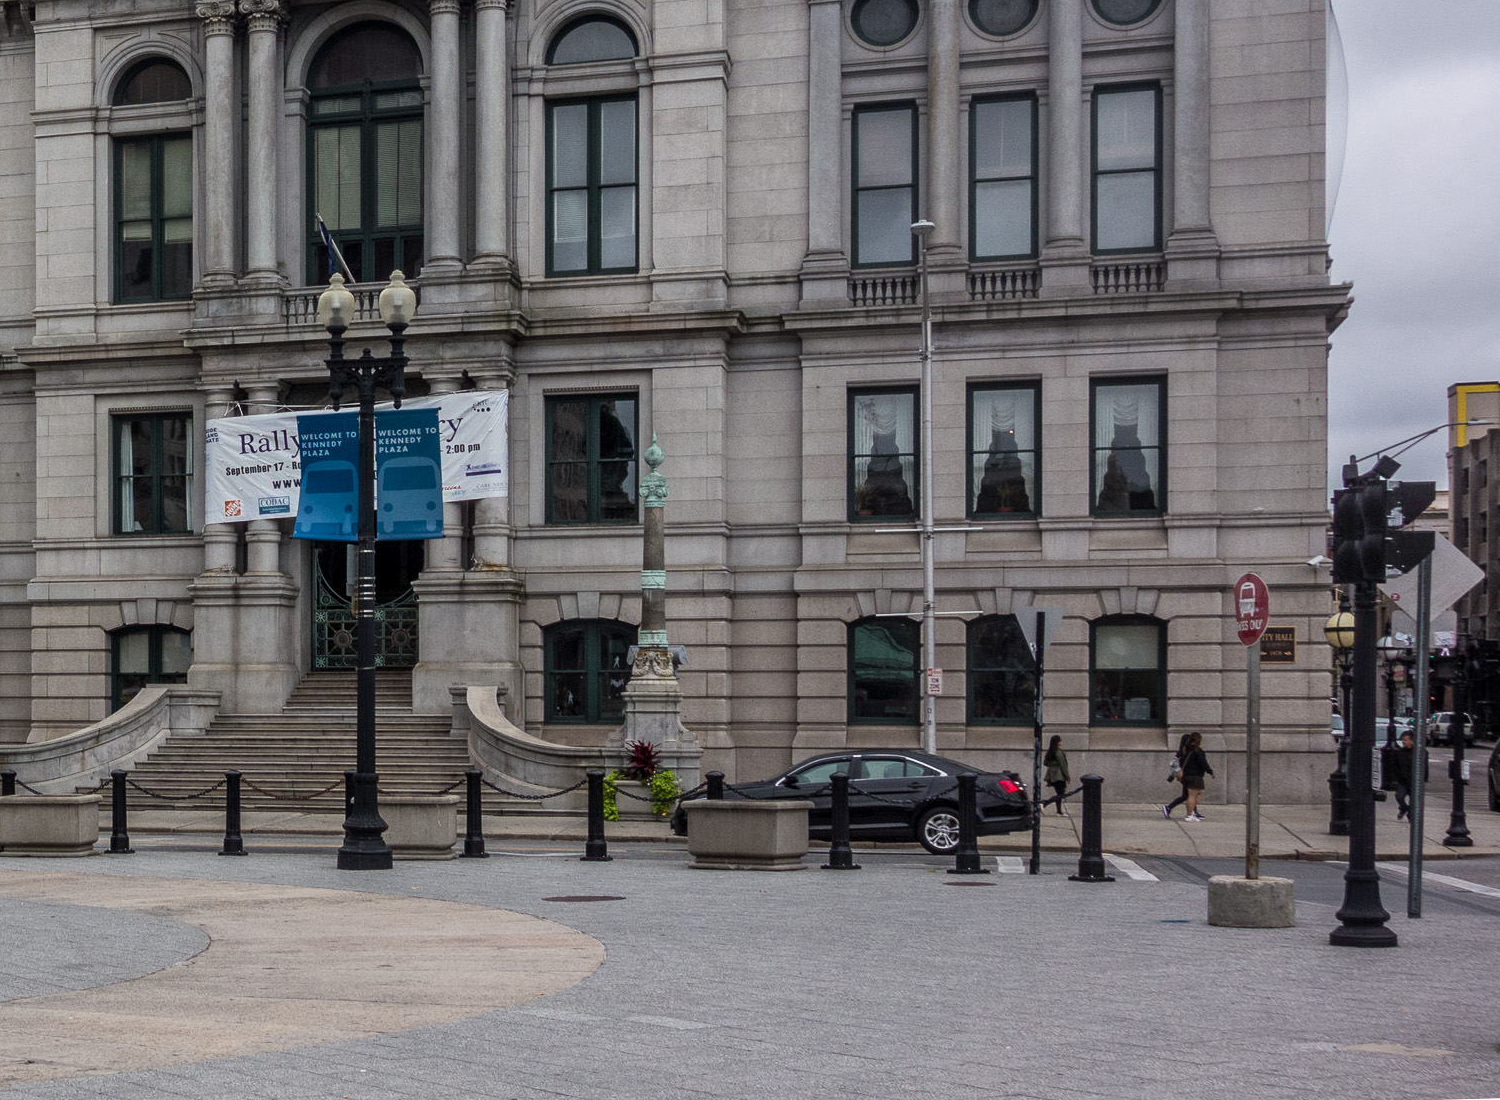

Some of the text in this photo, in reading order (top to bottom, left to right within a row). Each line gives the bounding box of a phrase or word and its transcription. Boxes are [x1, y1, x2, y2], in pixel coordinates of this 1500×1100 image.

[300, 431, 342, 440] WELCOME
[378, 428, 422, 436] WELCOME
[238, 429, 301, 458] Rally
[301, 440, 343, 449] KENNEDY
[378, 436, 422, 445] KENNEDY
[302, 449, 330, 457] PLAZA
[378, 445, 409, 454] PLAZA
[445, 444, 465, 454] 2:00
[468, 443, 481, 453] pm
[225, 464, 272, 476] September
[274, 462, 285, 472] 17
[260, 497, 288, 507] CODAC
[1261, 633, 1293, 641] ITY HALL
